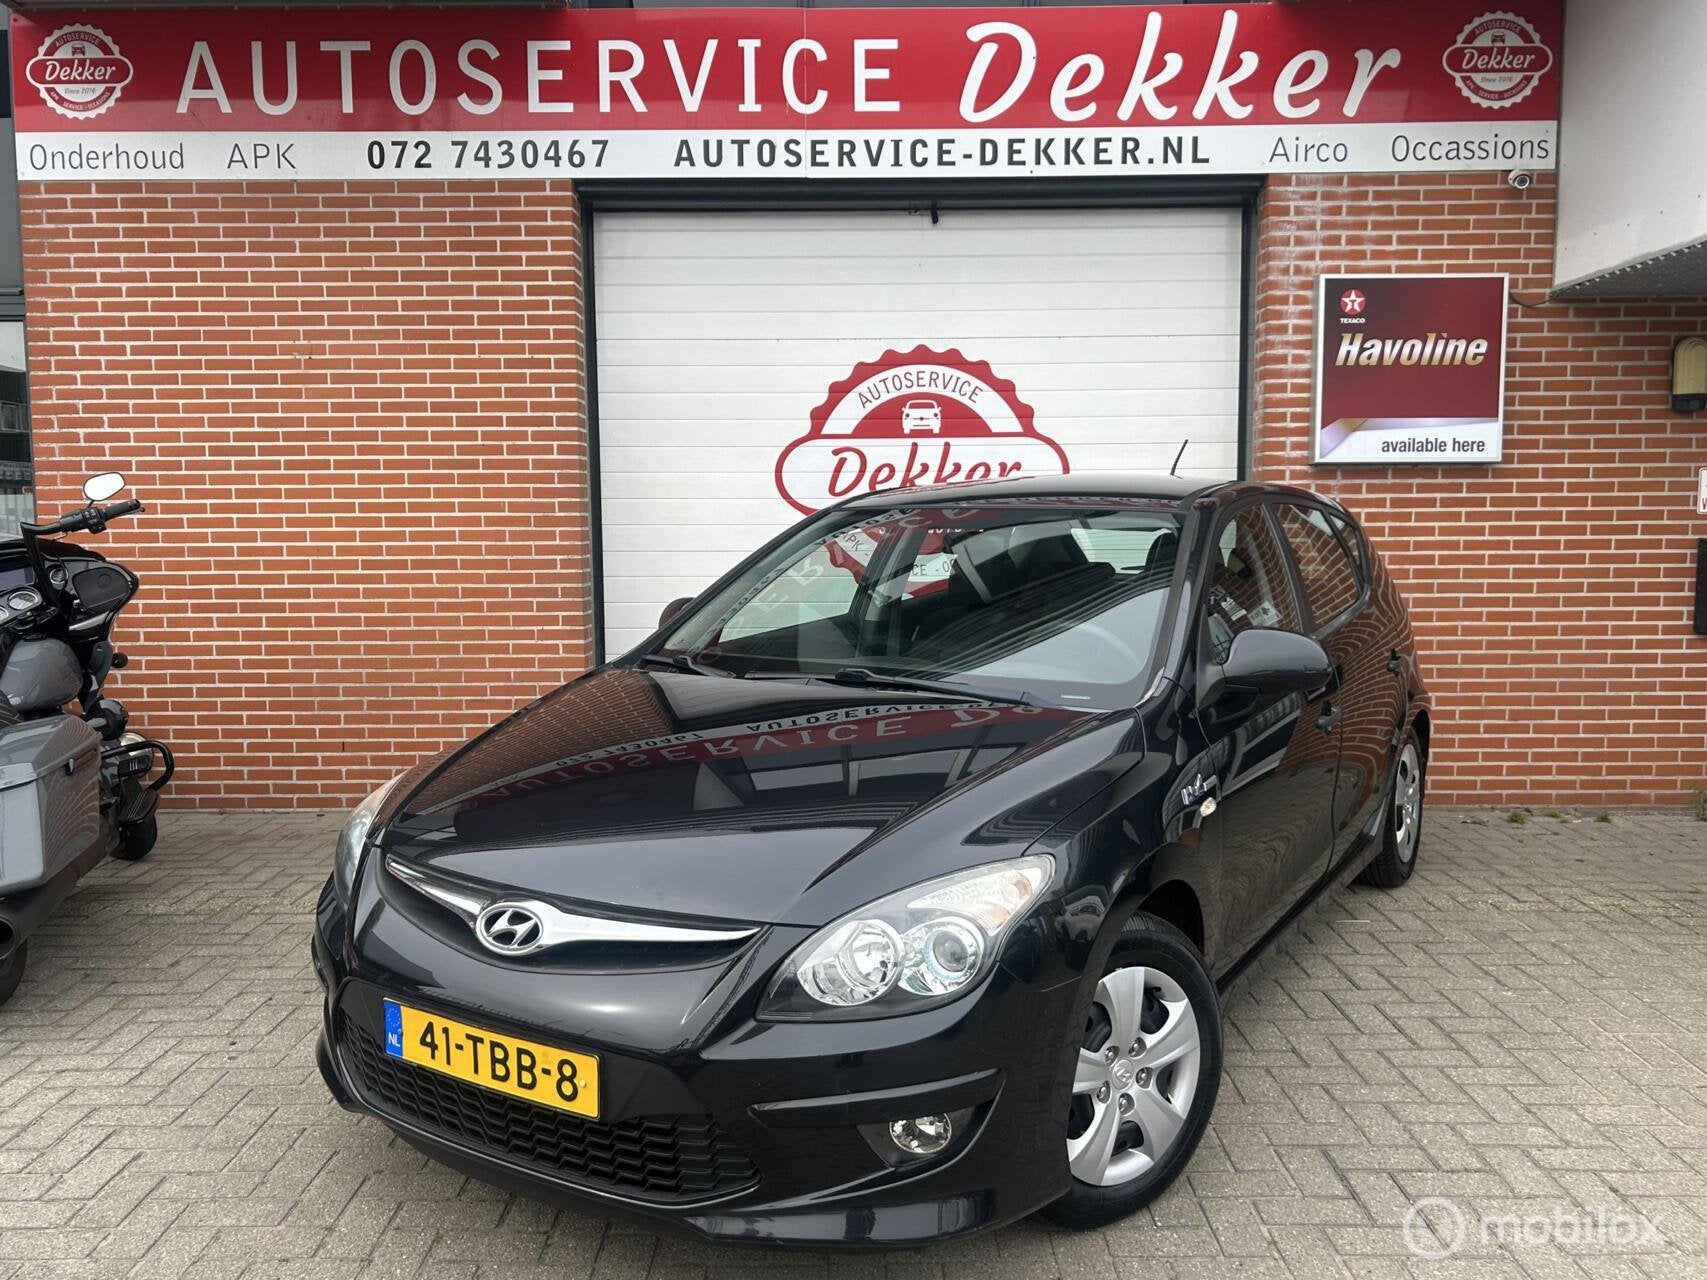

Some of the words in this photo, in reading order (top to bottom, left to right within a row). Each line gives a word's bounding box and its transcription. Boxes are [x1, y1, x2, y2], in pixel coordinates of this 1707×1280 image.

[1474, 20, 1522, 35] AUTOSERVICE
[55, 32, 101, 48] AUTOSERVICE
[44, 58, 116, 81] Dekker
[176, 39, 901, 116] AUTOSERVICE
[959, 9, 1401, 123] Dekker
[1462, 47, 1536, 69] Dekker
[29, 143, 185, 171] Onderhoud
[227, 143, 297, 170] APK
[367, 140, 432, 170] 072
[451, 139, 610, 170] 7430467
[673, 136, 1210, 169] AUTOSERVICE-DEKKER.NL
[1269, 136, 1348, 164] Airco
[1391, 132, 1549, 161] Occassions
[1335, 332, 1488, 366] Havoline
[858, 370, 984, 409] AUTOSERVICE
[1381, 437, 1447, 453] available
[1452, 437, 1485, 453] here
[388, 1032, 401, 1047] NL
[419, 1020, 579, 1102] 41-TBB-8
